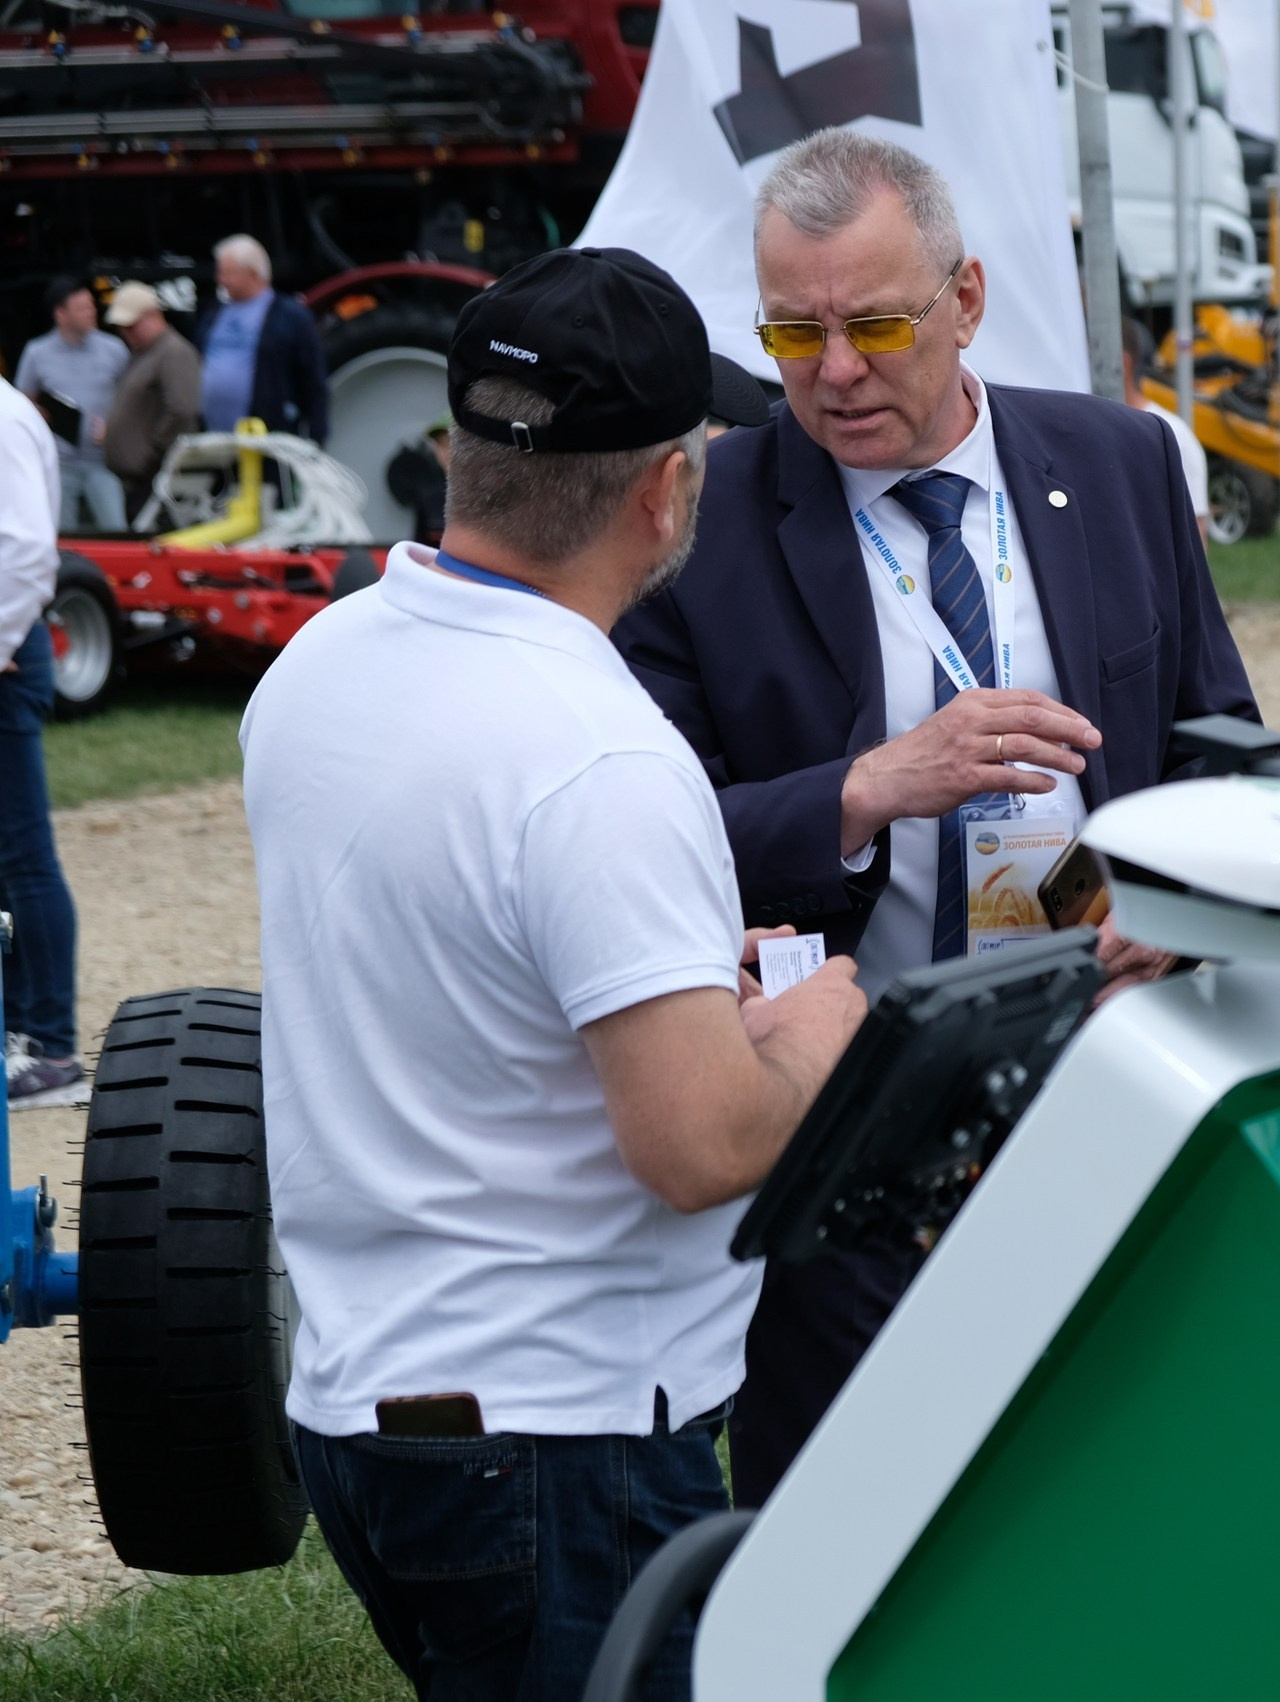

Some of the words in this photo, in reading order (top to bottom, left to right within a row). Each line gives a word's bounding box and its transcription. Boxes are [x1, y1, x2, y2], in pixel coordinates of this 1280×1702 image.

[995, 491, 1006, 516] НИВА
[855, 508, 876, 535] НИВА
[997, 517, 1008, 560] ЗОЛОТАЯ
[871, 533, 902, 574] ЗОЛОТАЯ
[942, 644, 963, 672] НИВА
[1002, 643, 1011, 670] НИВА
[1003, 840, 1042, 850] ЗОЛОТАЯ
[1044, 838, 1066, 847] НИВА
